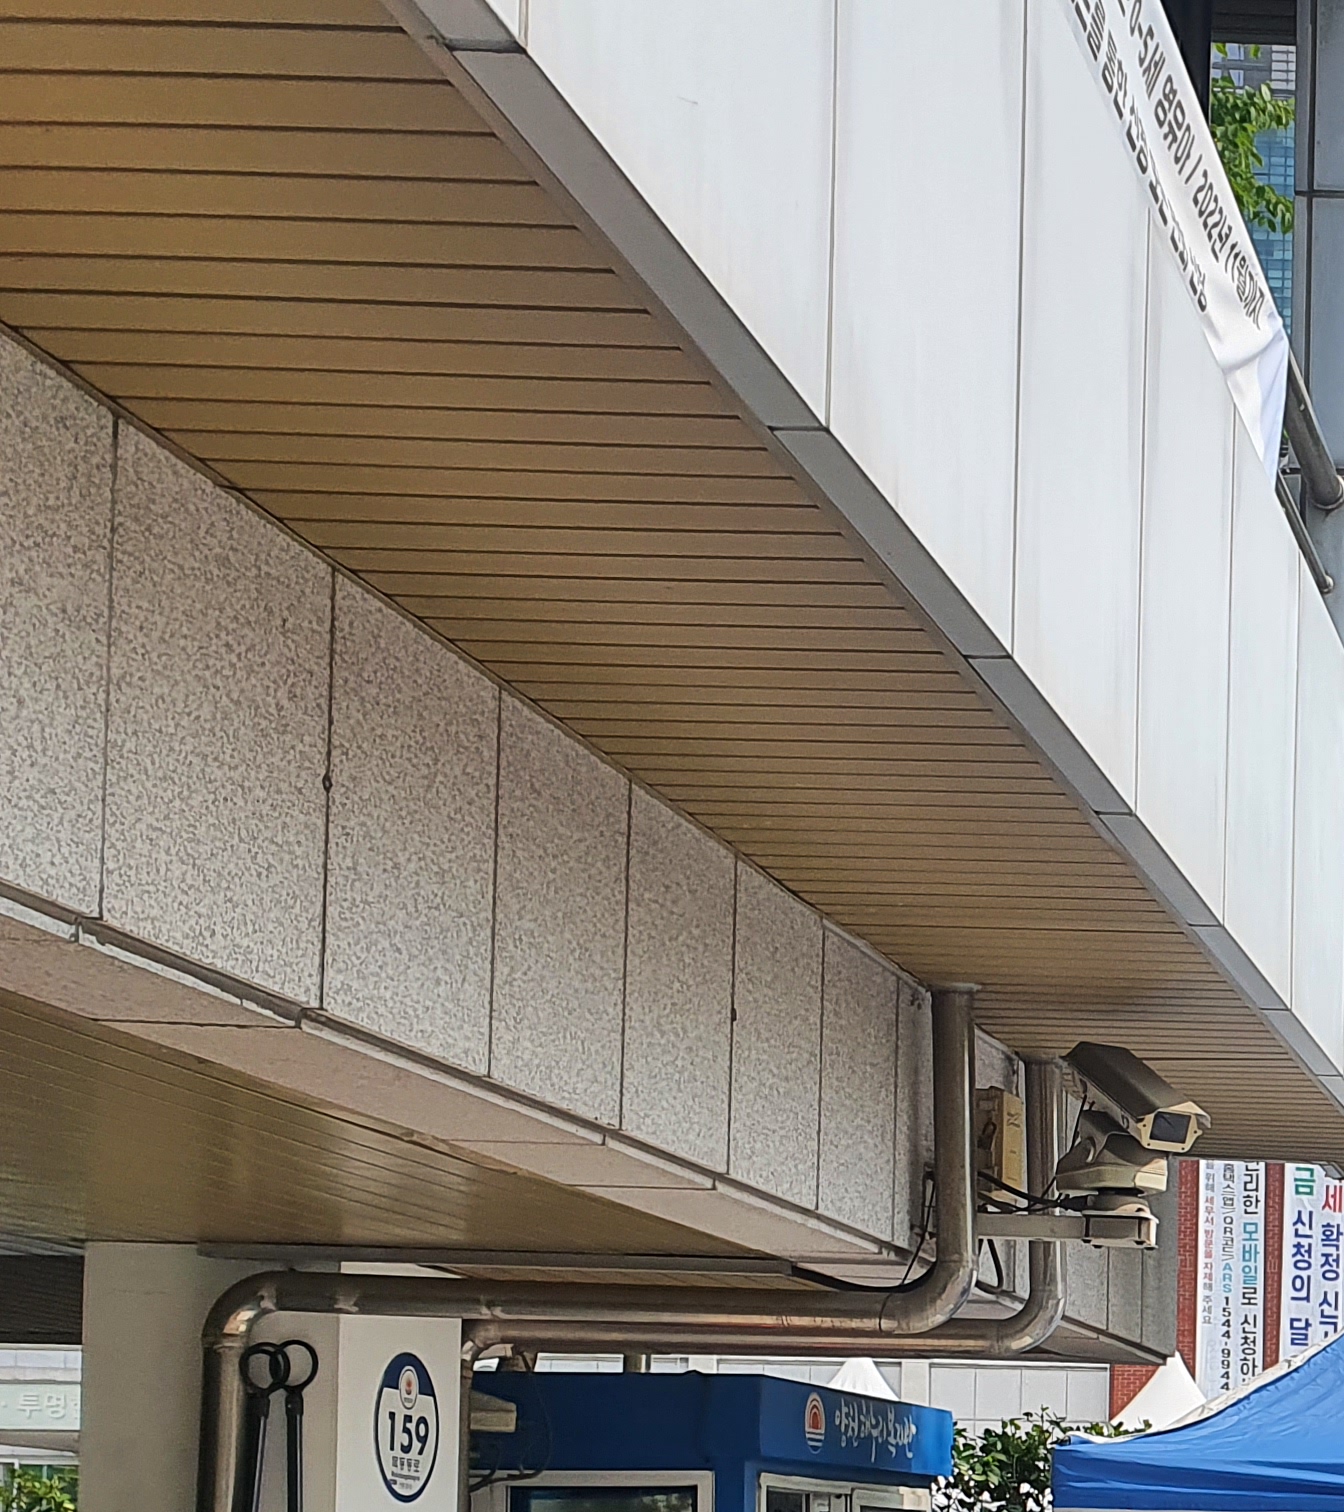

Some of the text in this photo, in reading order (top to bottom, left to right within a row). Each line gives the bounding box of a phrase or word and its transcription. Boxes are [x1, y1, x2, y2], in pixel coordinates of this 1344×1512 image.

[1154, 74, 1195, 175] 영유아
[1193, 168, 1233, 263] 2022년
[1321, 1173, 1344, 1213] 세
[1240, 1221, 1260, 1306] 모바일로
[1290, 1210, 1314, 1304] 신청의
[1320, 1222, 1344, 1282] 확정
[1201, 1295, 1213, 1325] 주세요
[1289, 1318, 1312, 1347] 달
[1220, 1296, 1233, 1392] 1544-9944
[1240, 1313, 1259, 1384] 신청하
[388, 1411, 429, 1456] 159
